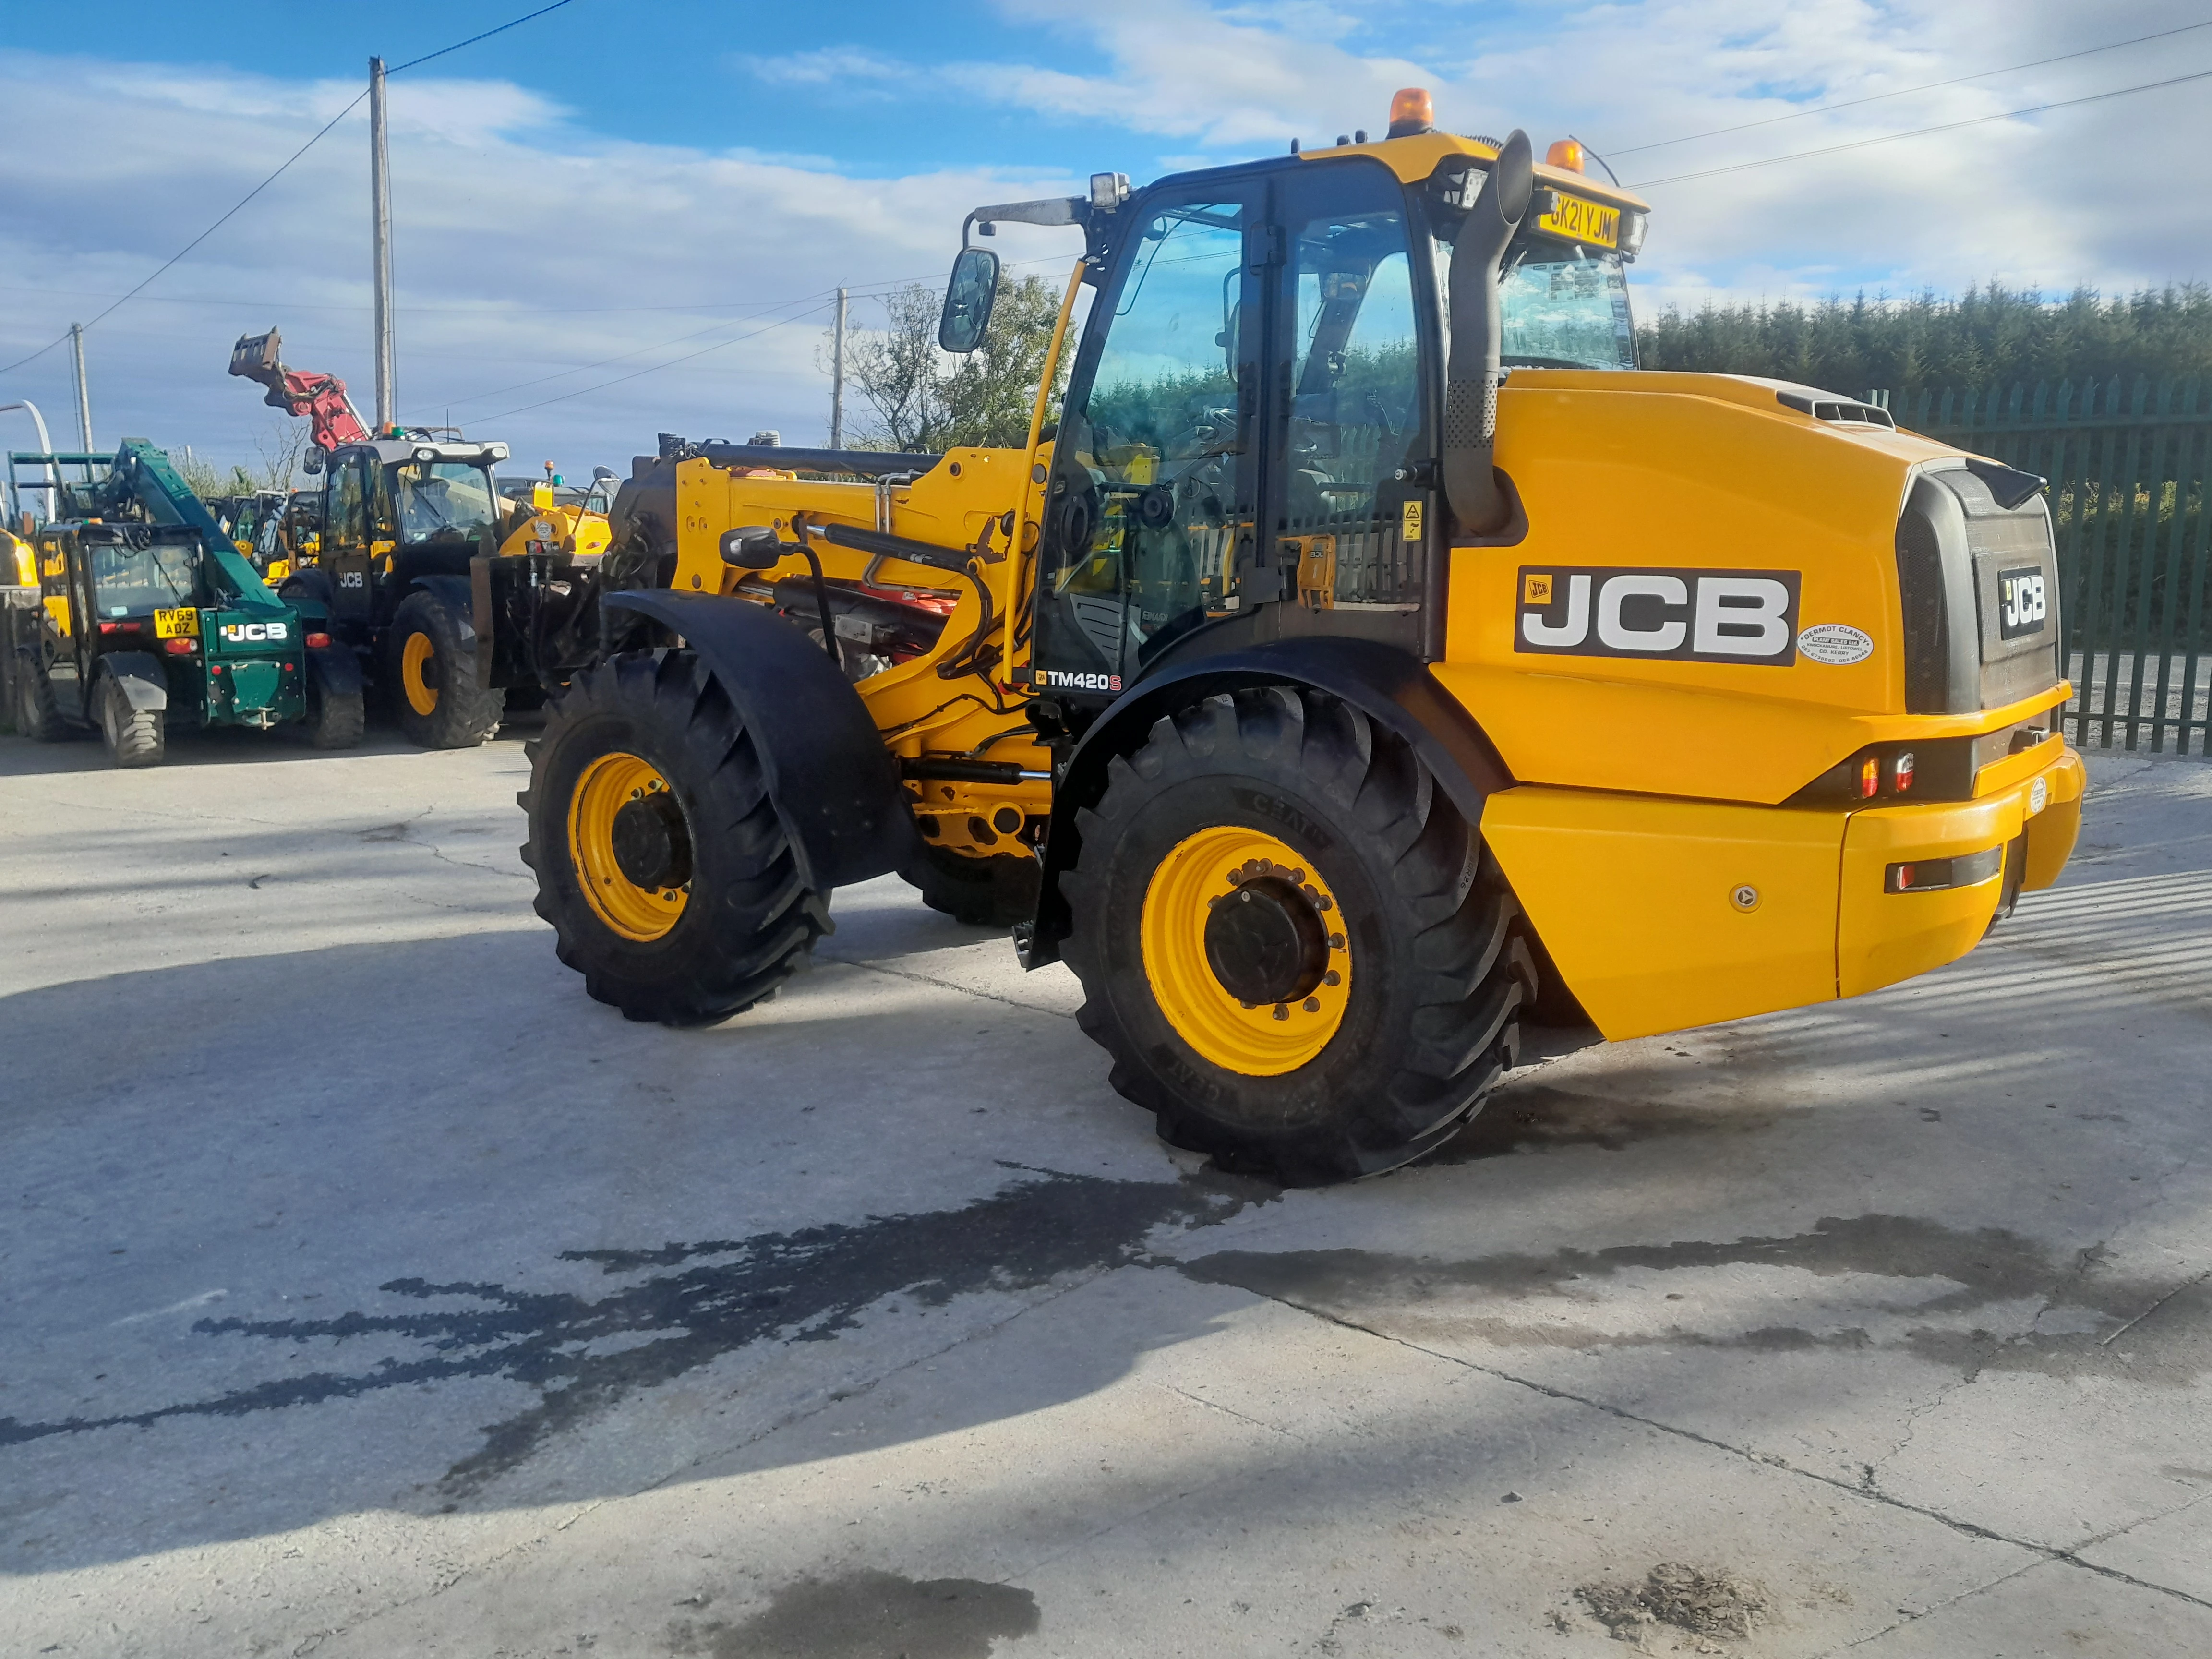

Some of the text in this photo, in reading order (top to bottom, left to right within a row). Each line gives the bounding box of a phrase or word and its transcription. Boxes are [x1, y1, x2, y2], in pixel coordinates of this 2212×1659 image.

[1587, 205, 1612, 240] YJM
[340, 572, 363, 587] JCB
[1532, 582, 1547, 596] JCB
[2007, 576, 2046, 626] JCB
[159, 609, 193, 621] RV69
[1522, 575, 1790, 656] JCB
[228, 623, 287, 641] JCB
[1803, 626, 1868, 644] DERMOT CLANCY
[1048, 671, 1122, 691] TM420S
